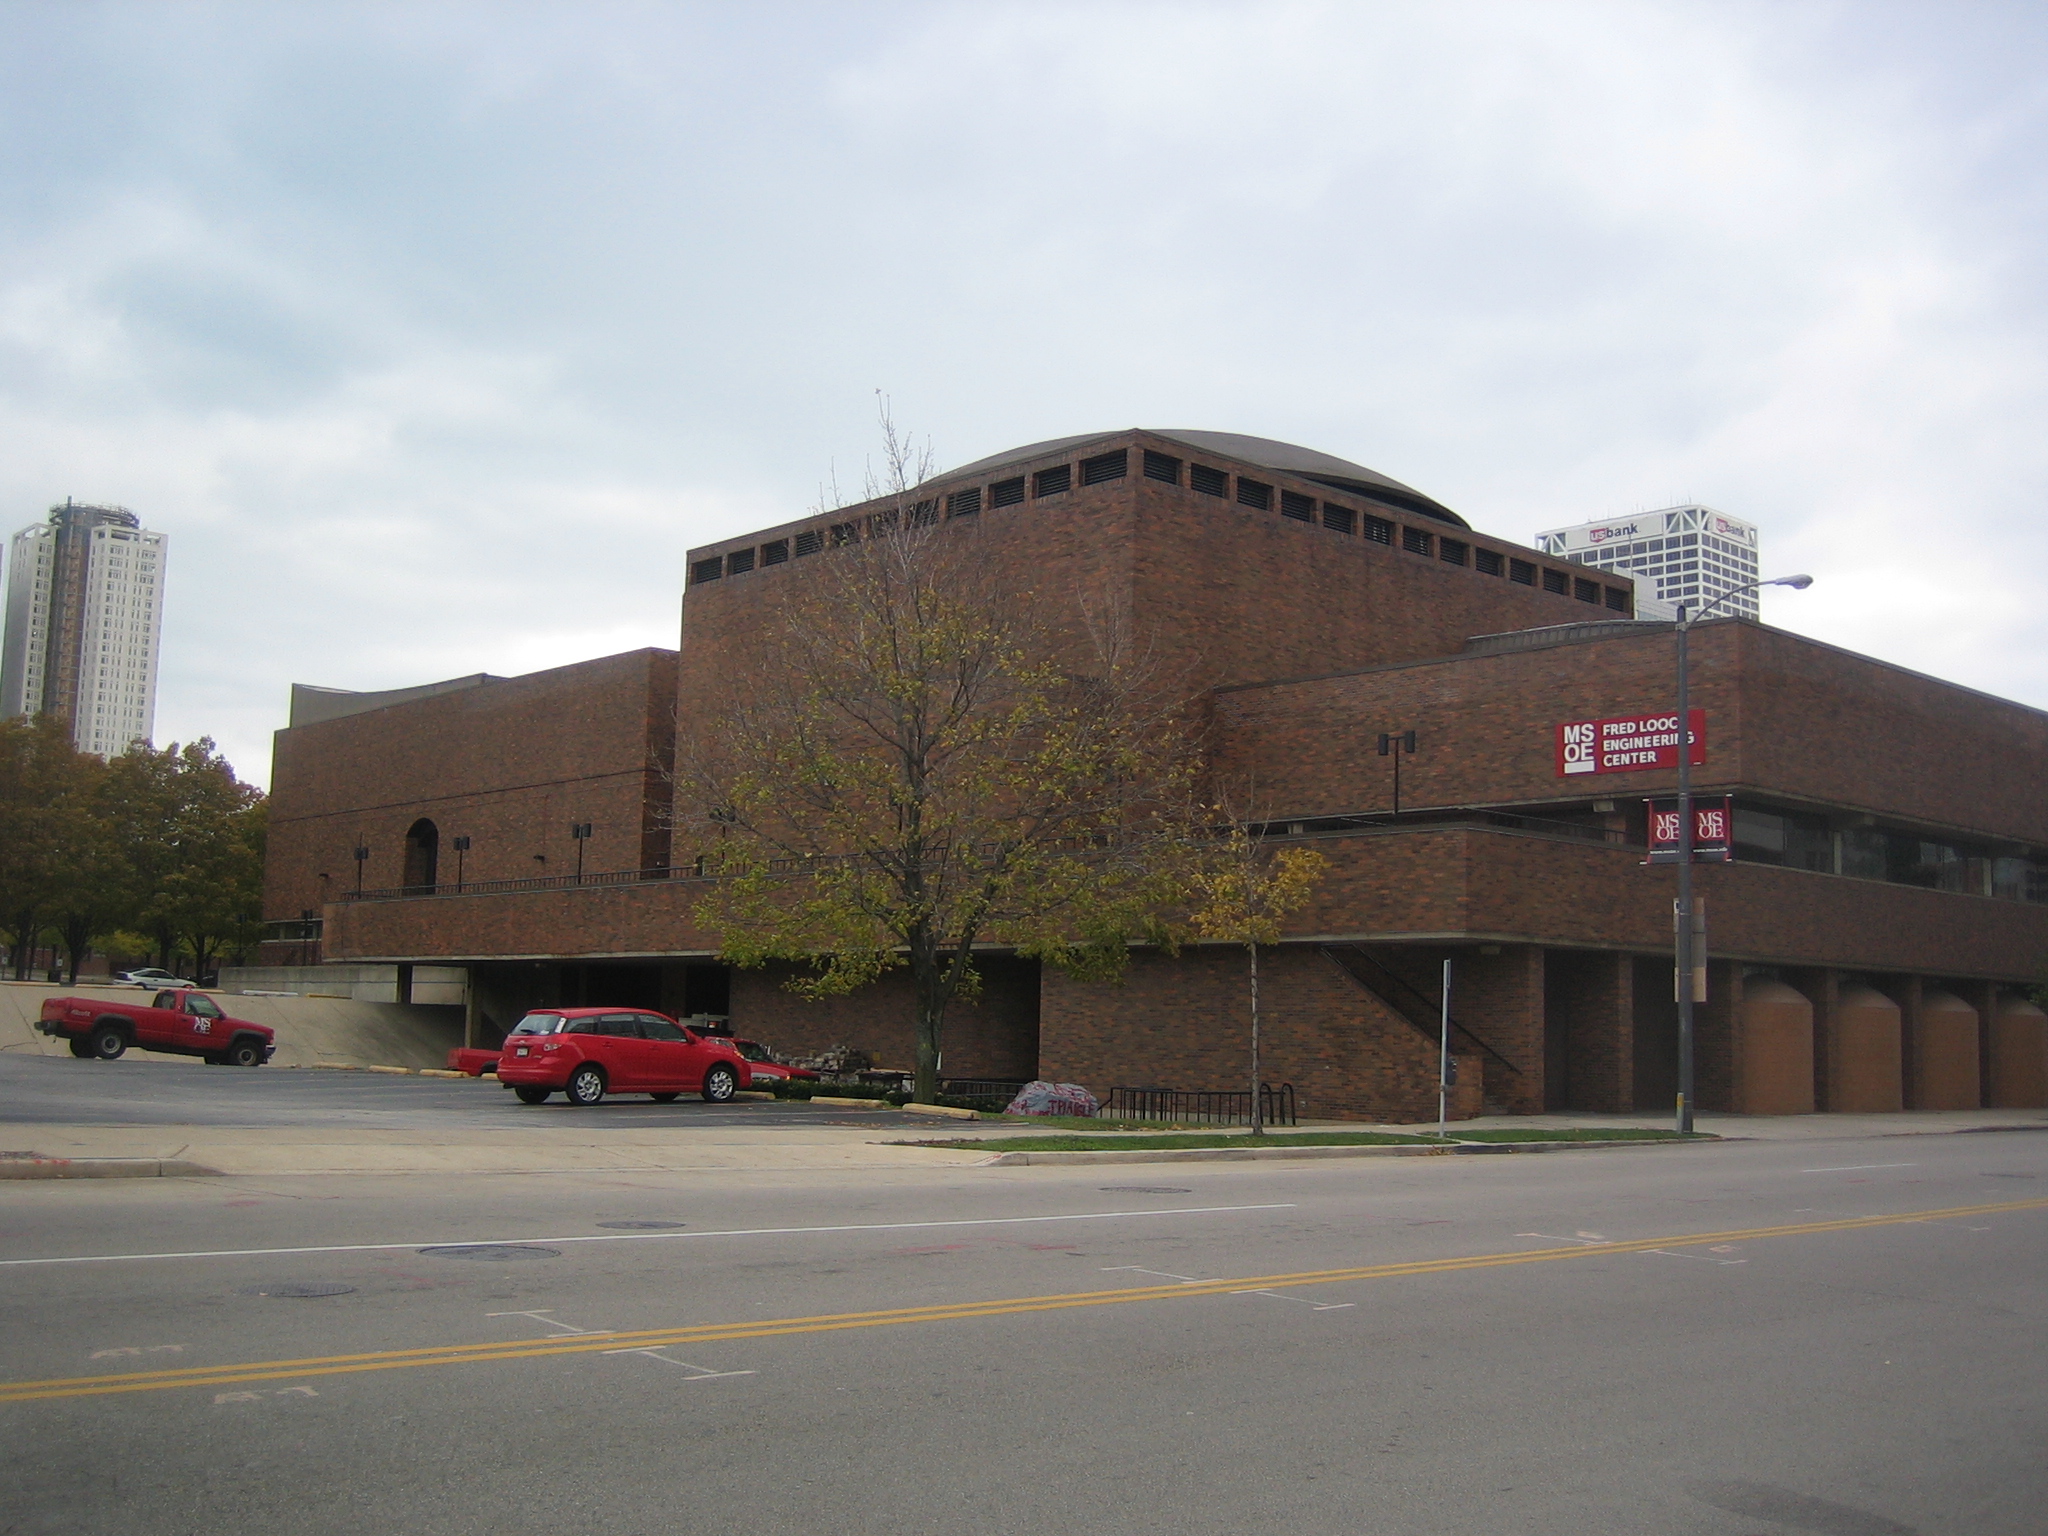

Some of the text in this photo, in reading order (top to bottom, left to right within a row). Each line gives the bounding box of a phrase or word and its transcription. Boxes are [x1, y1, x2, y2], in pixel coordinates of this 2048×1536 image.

[1564, 723, 1595, 744] MS
[1603, 717, 1678, 736] FRED LOOC
[1564, 742, 1594, 762] OE
[1603, 751, 1657, 767] CENTER
[1656, 813, 1680, 828] MS
[1698, 811, 1723, 827] MS
[1698, 824, 1724, 839] OE
